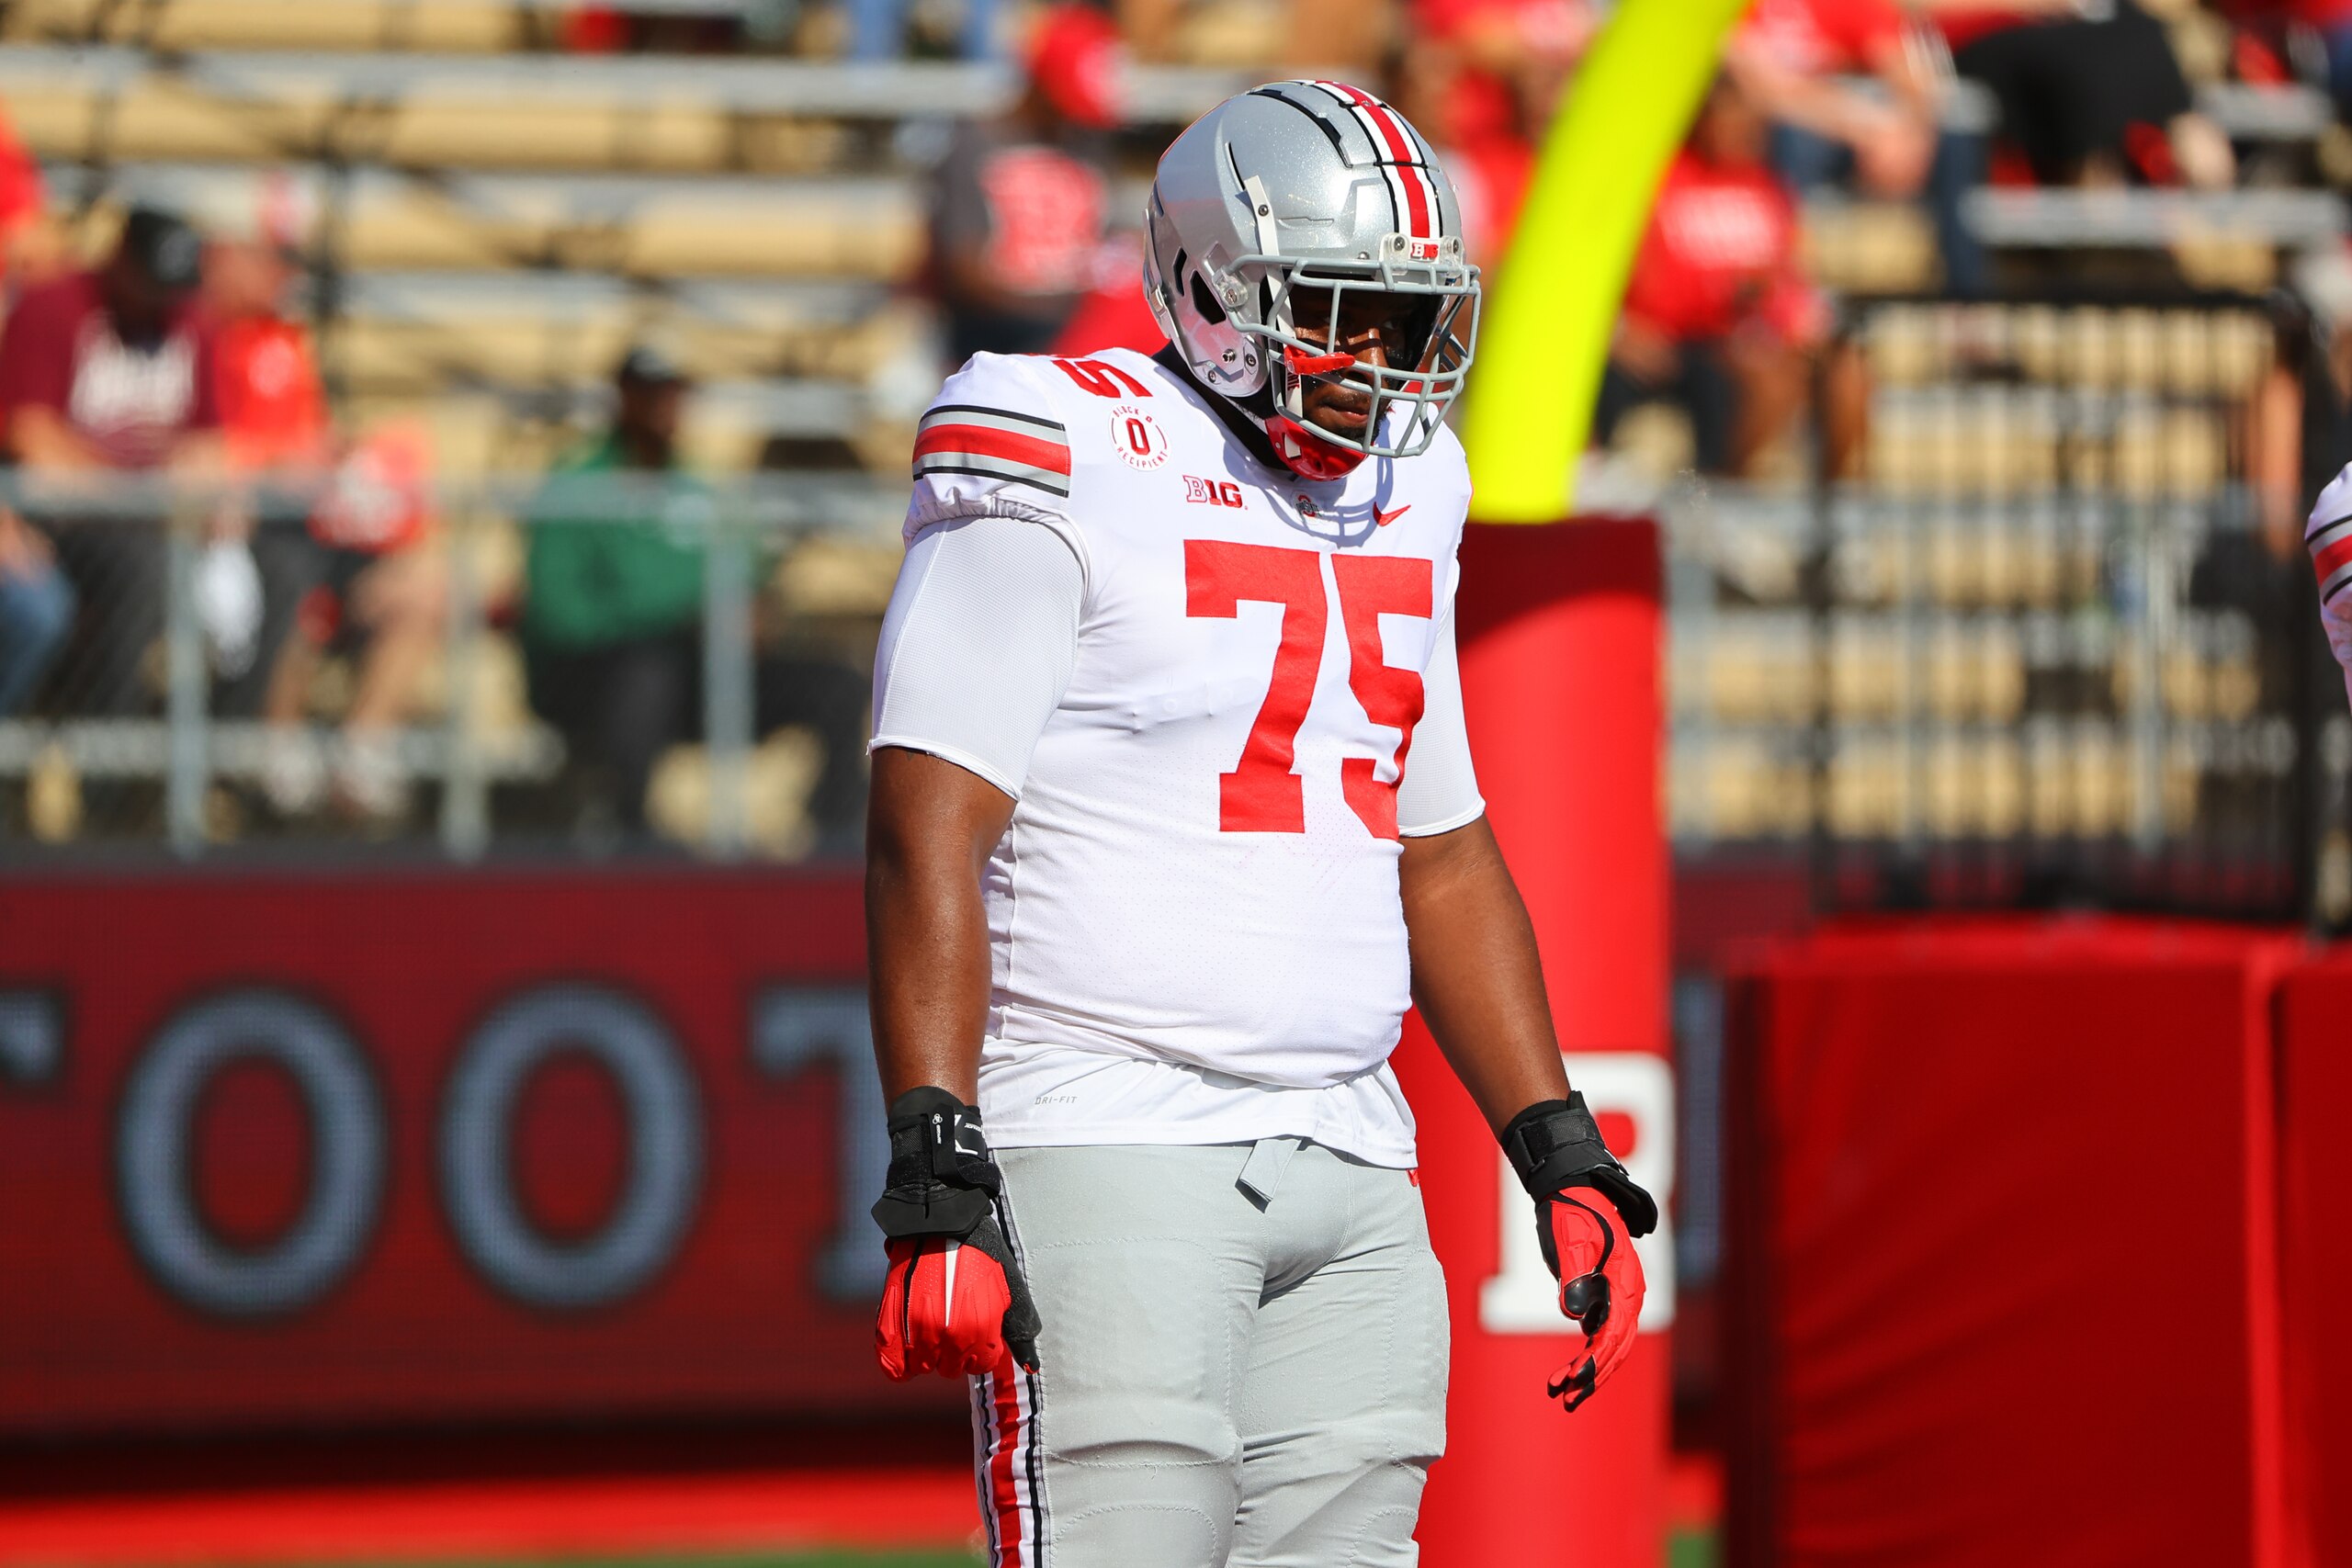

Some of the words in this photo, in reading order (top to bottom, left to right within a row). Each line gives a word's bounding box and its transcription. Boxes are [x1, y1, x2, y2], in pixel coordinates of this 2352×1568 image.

[1117, 446, 1168, 468] RECIPIENT
[1183, 539, 1432, 840] 75
[0, 981, 889, 1314] OOT
[1035, 1096, 1078, 1105] DRI-FIT
